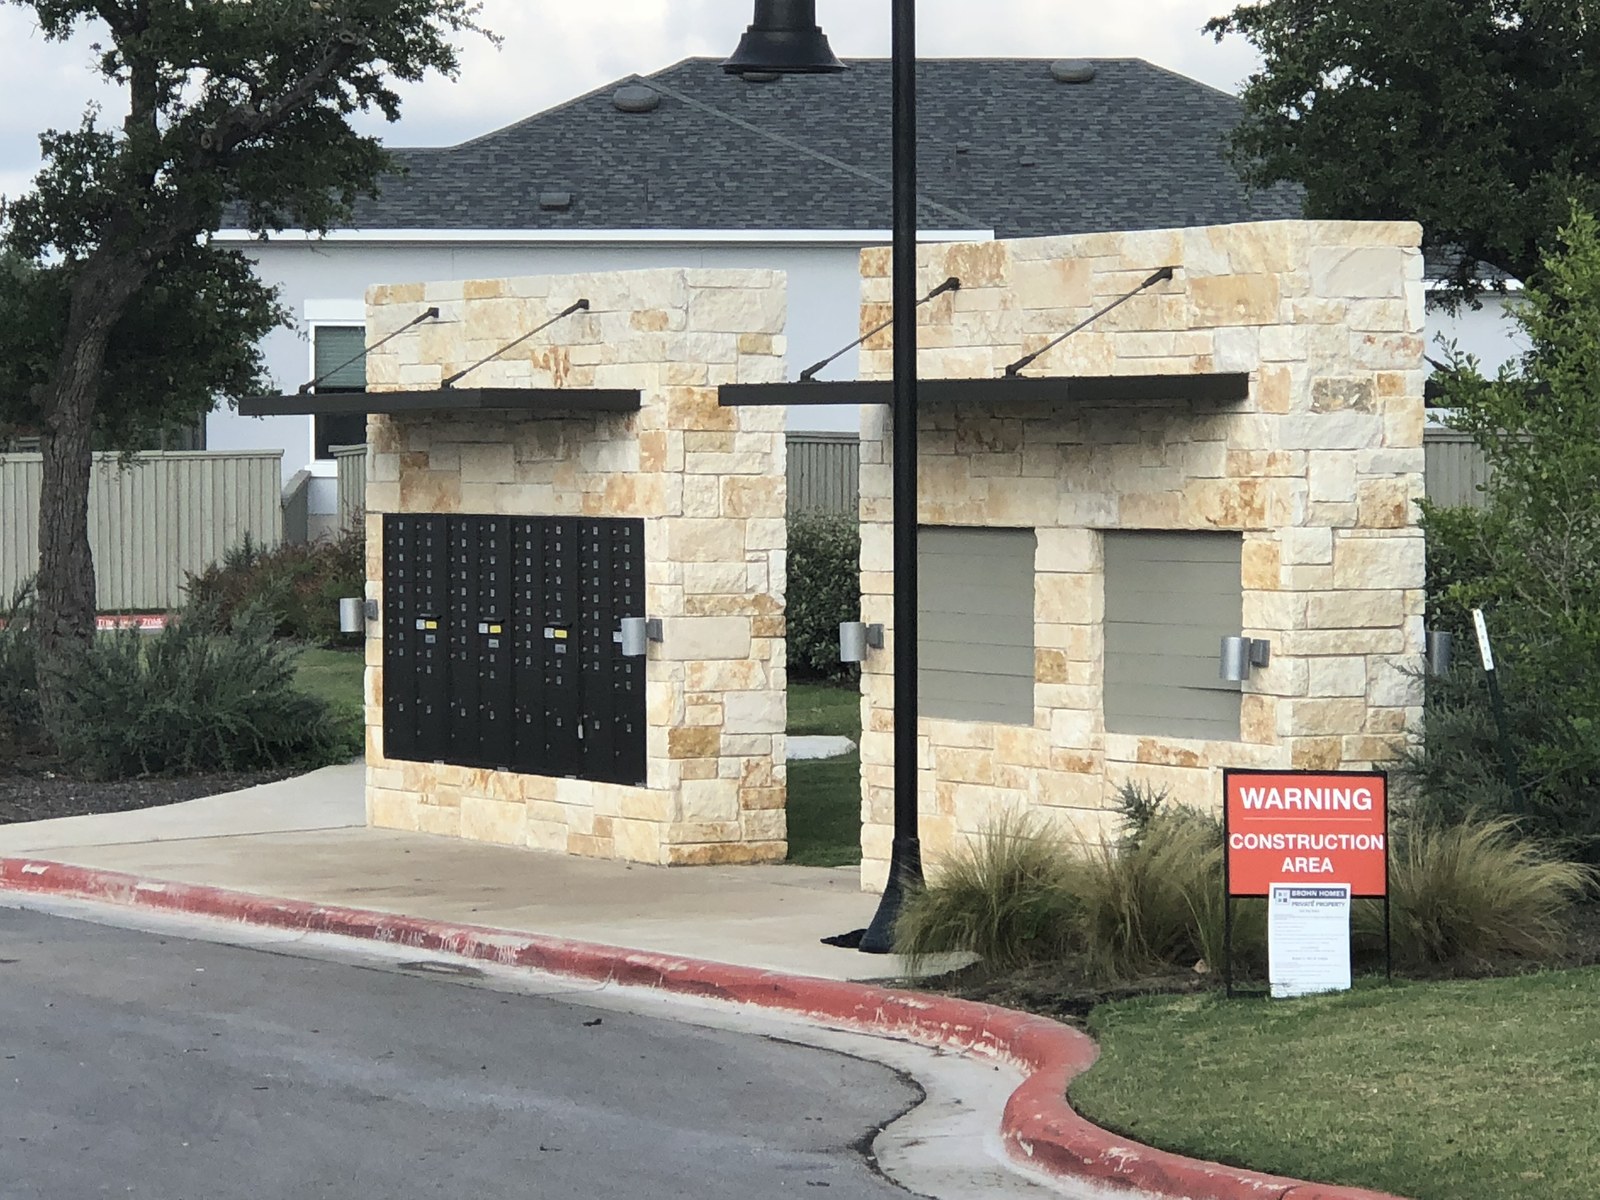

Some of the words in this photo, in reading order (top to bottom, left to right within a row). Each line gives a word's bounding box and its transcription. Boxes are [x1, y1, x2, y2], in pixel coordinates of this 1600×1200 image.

[1239, 787, 1373, 811] WARNING
[1230, 833, 1384, 850] CONSTRUCTION
[1281, 857, 1334, 873] AREA
